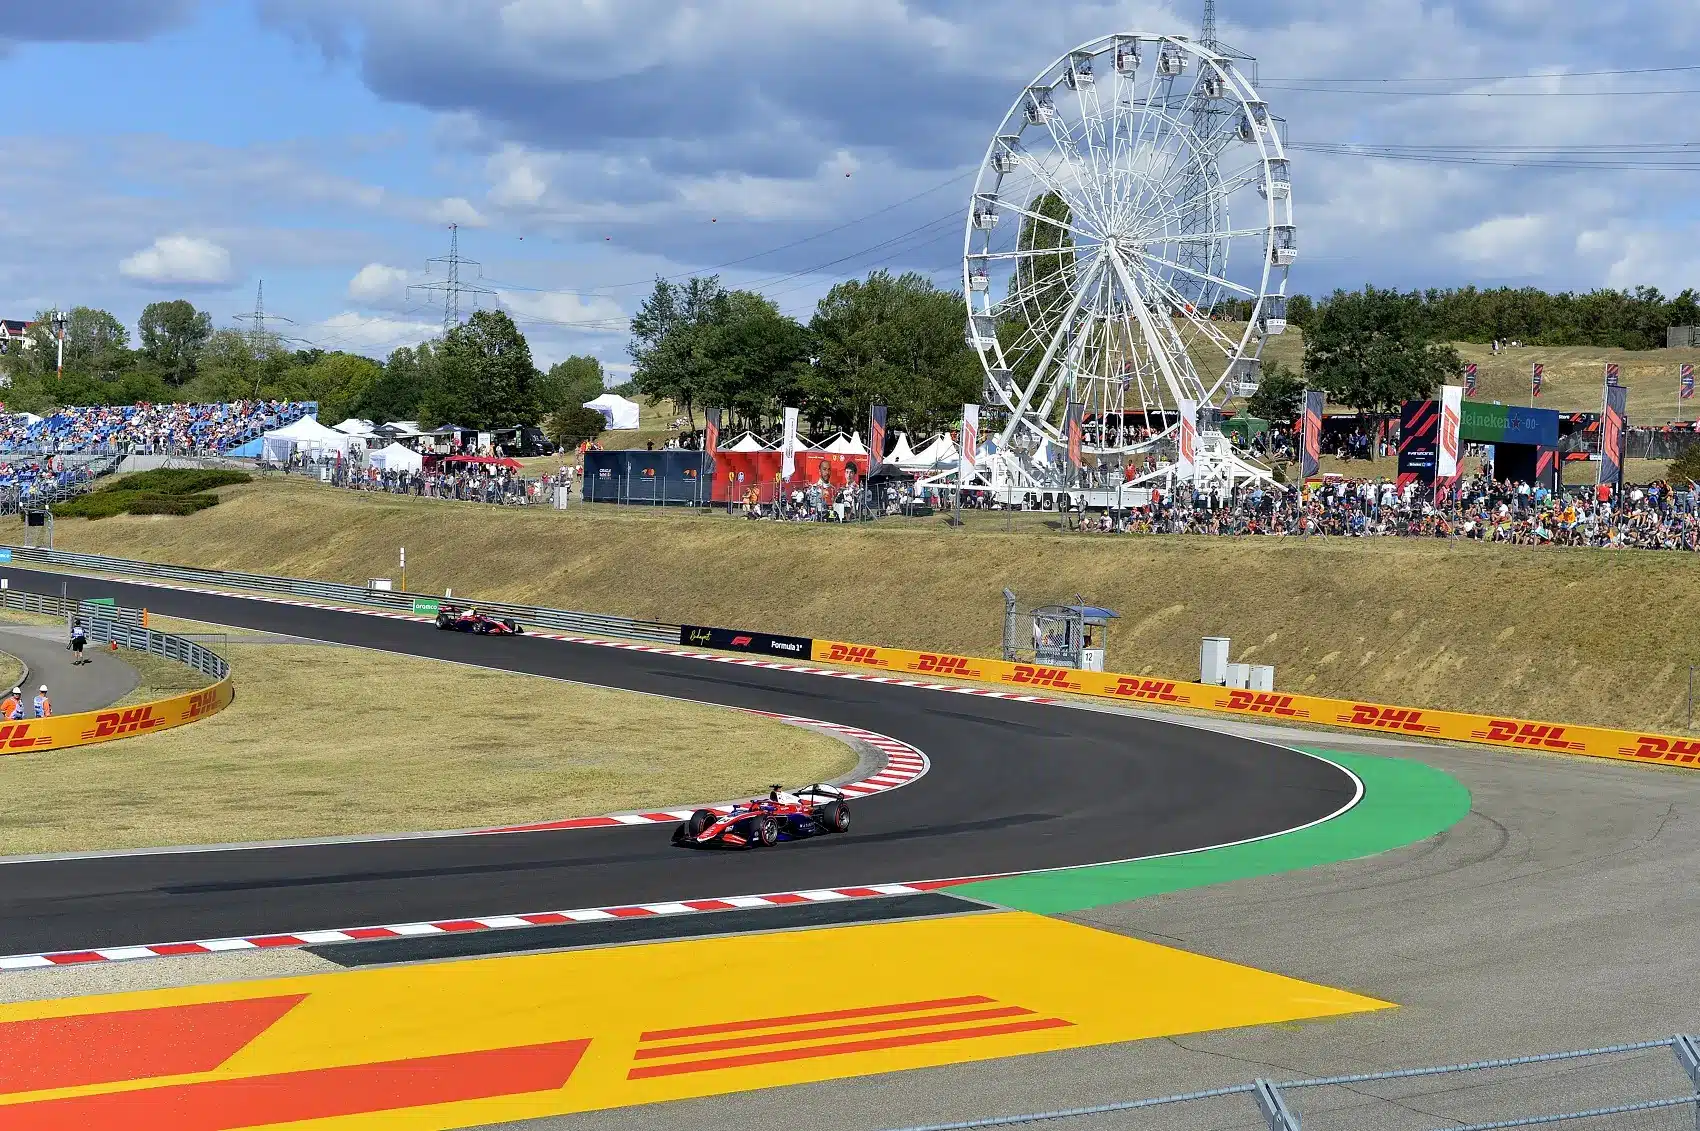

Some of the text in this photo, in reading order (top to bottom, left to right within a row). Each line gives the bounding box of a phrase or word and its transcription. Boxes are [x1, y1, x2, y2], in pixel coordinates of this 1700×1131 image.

[771, 640, 796, 650] Formula
[829, 645, 878, 664] DHL
[1085, 652, 1093, 661] 12
[917, 655, 970, 676] DHL
[1012, 666, 1070, 688] DHL
[1116, 678, 1177, 702] DHL
[189, 689, 217, 717] DHL
[1227, 691, 1296, 716] DHL
[94, 707, 157, 738] DHL
[1351, 705, 1426, 732] DHL
[1486, 720, 1569, 748] DHL
[1635, 737, 1700, 763] DH
